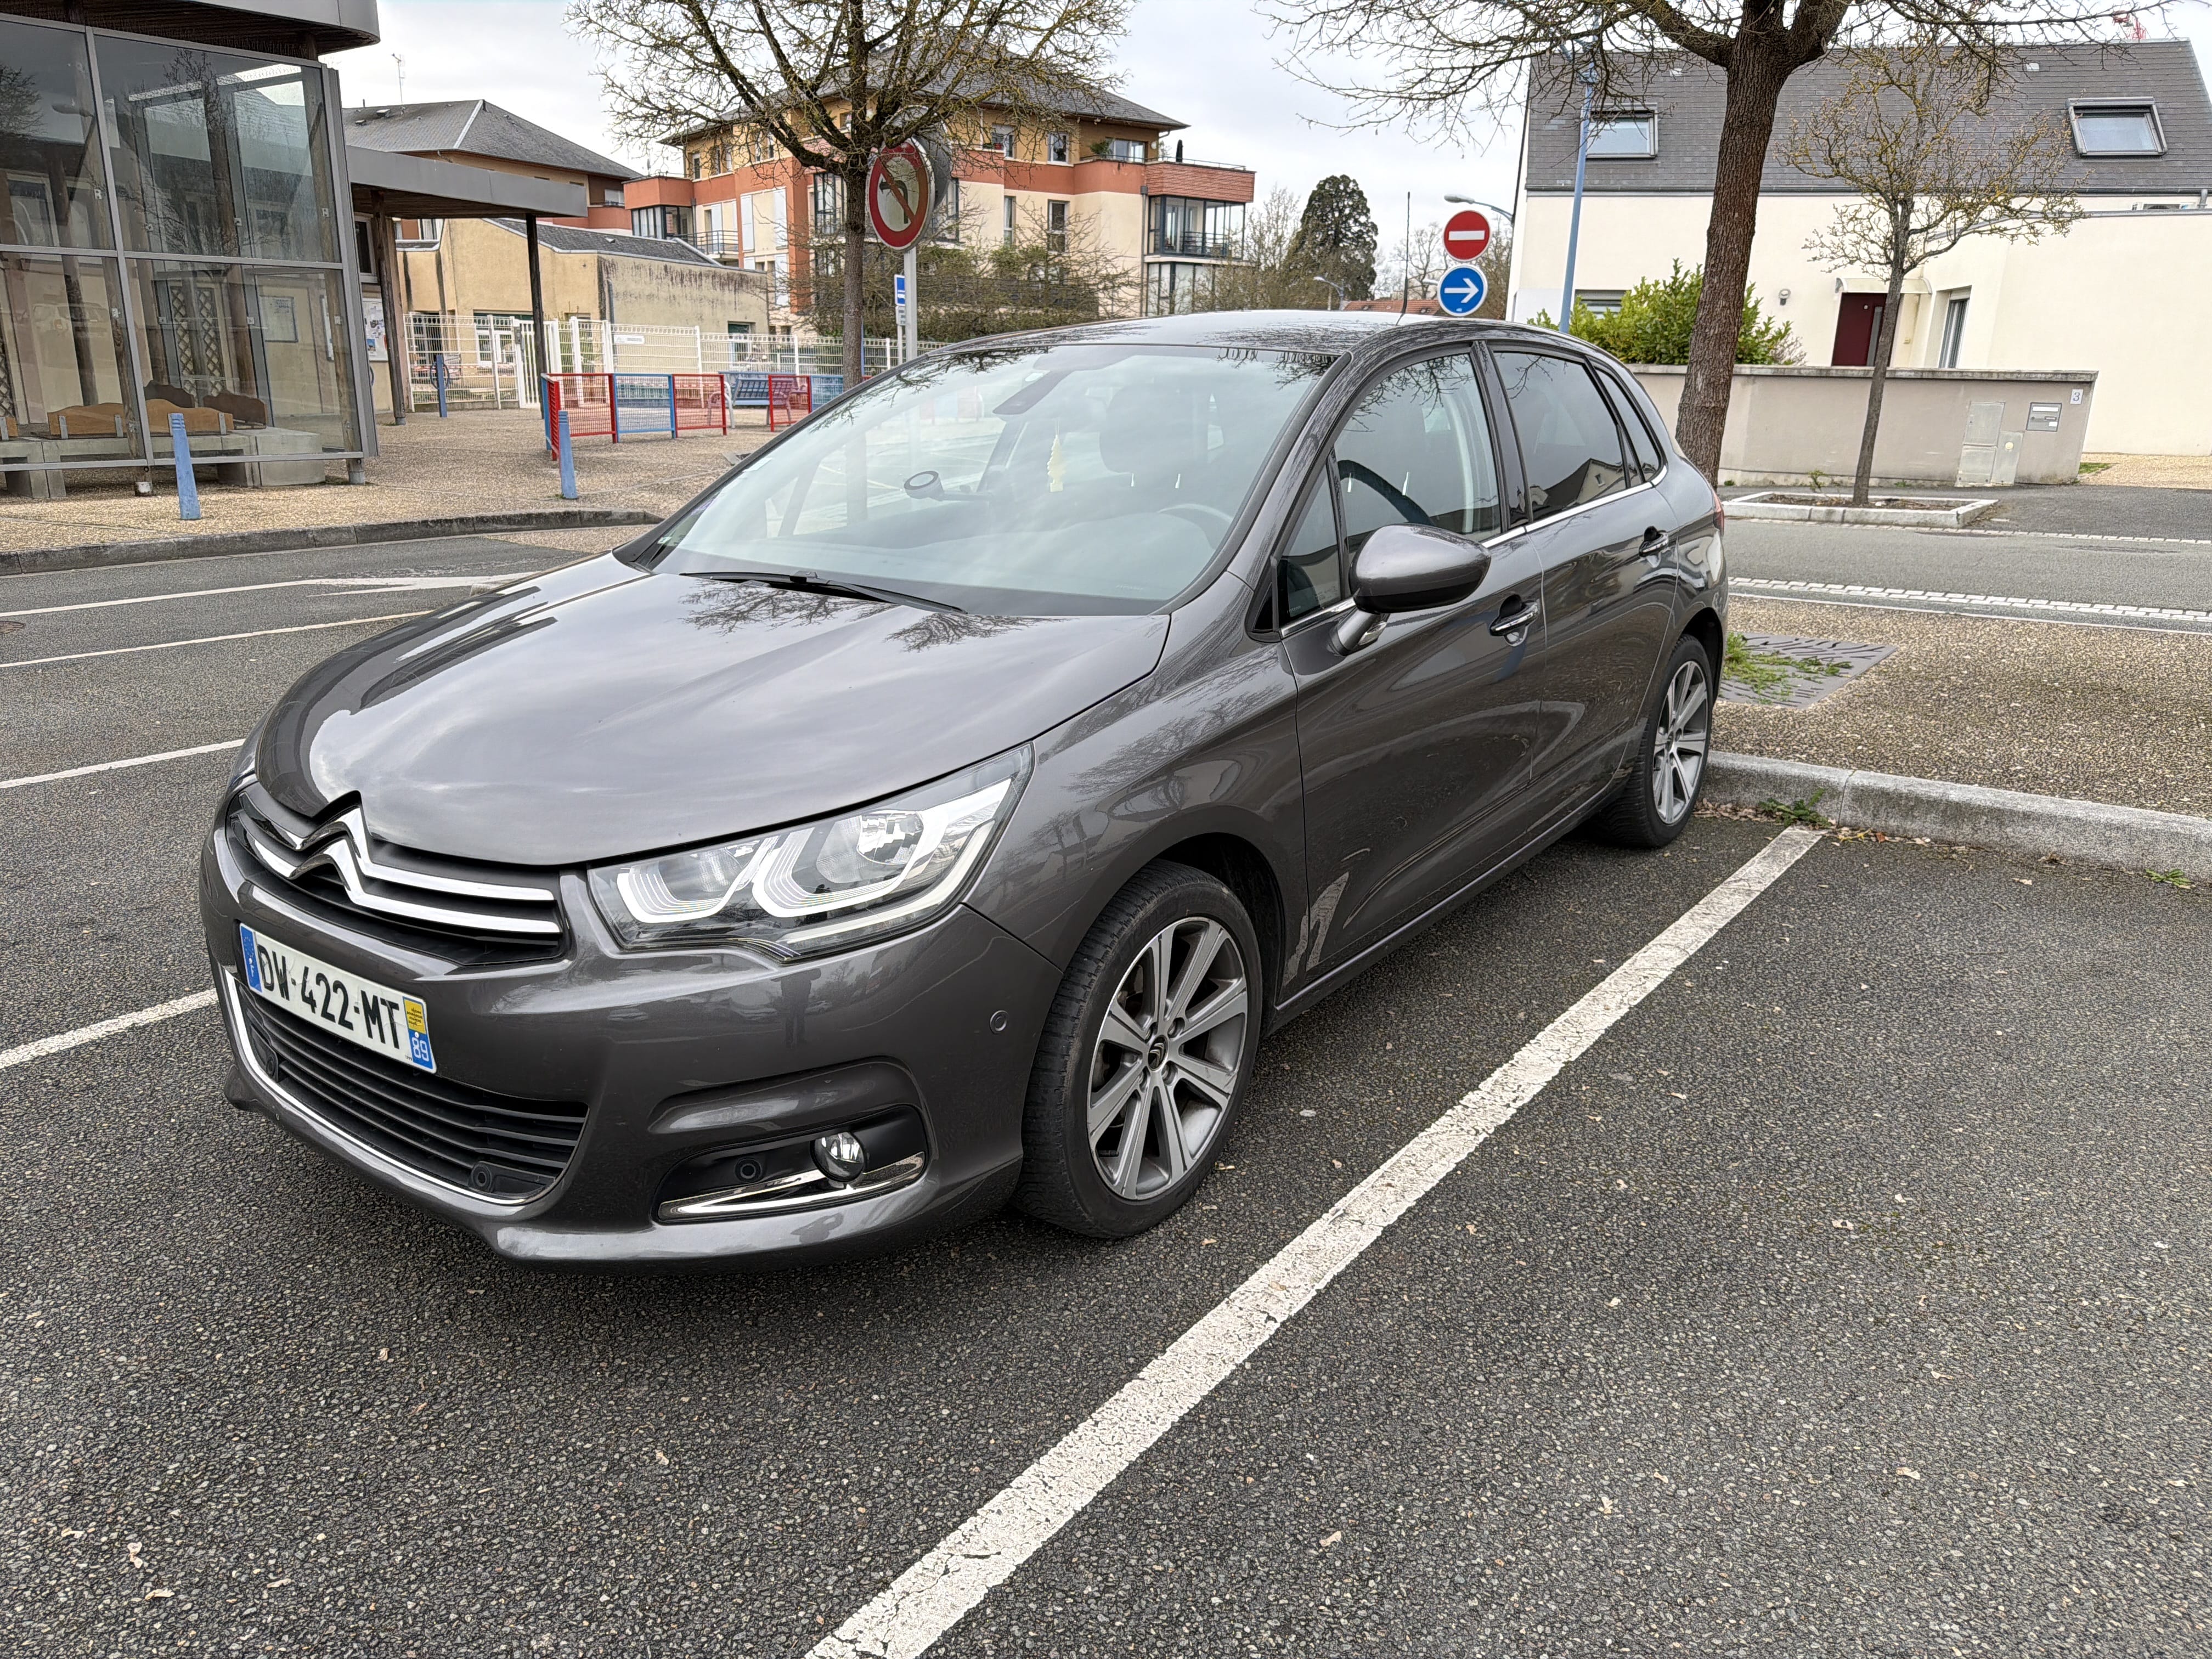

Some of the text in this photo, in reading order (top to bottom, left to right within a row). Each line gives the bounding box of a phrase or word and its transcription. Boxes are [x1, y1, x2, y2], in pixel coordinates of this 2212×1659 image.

[2073, 392, 2080, 401] 3
[257, 944, 399, 1049] DW-422-MT
[412, 1036, 430, 1062] 89
